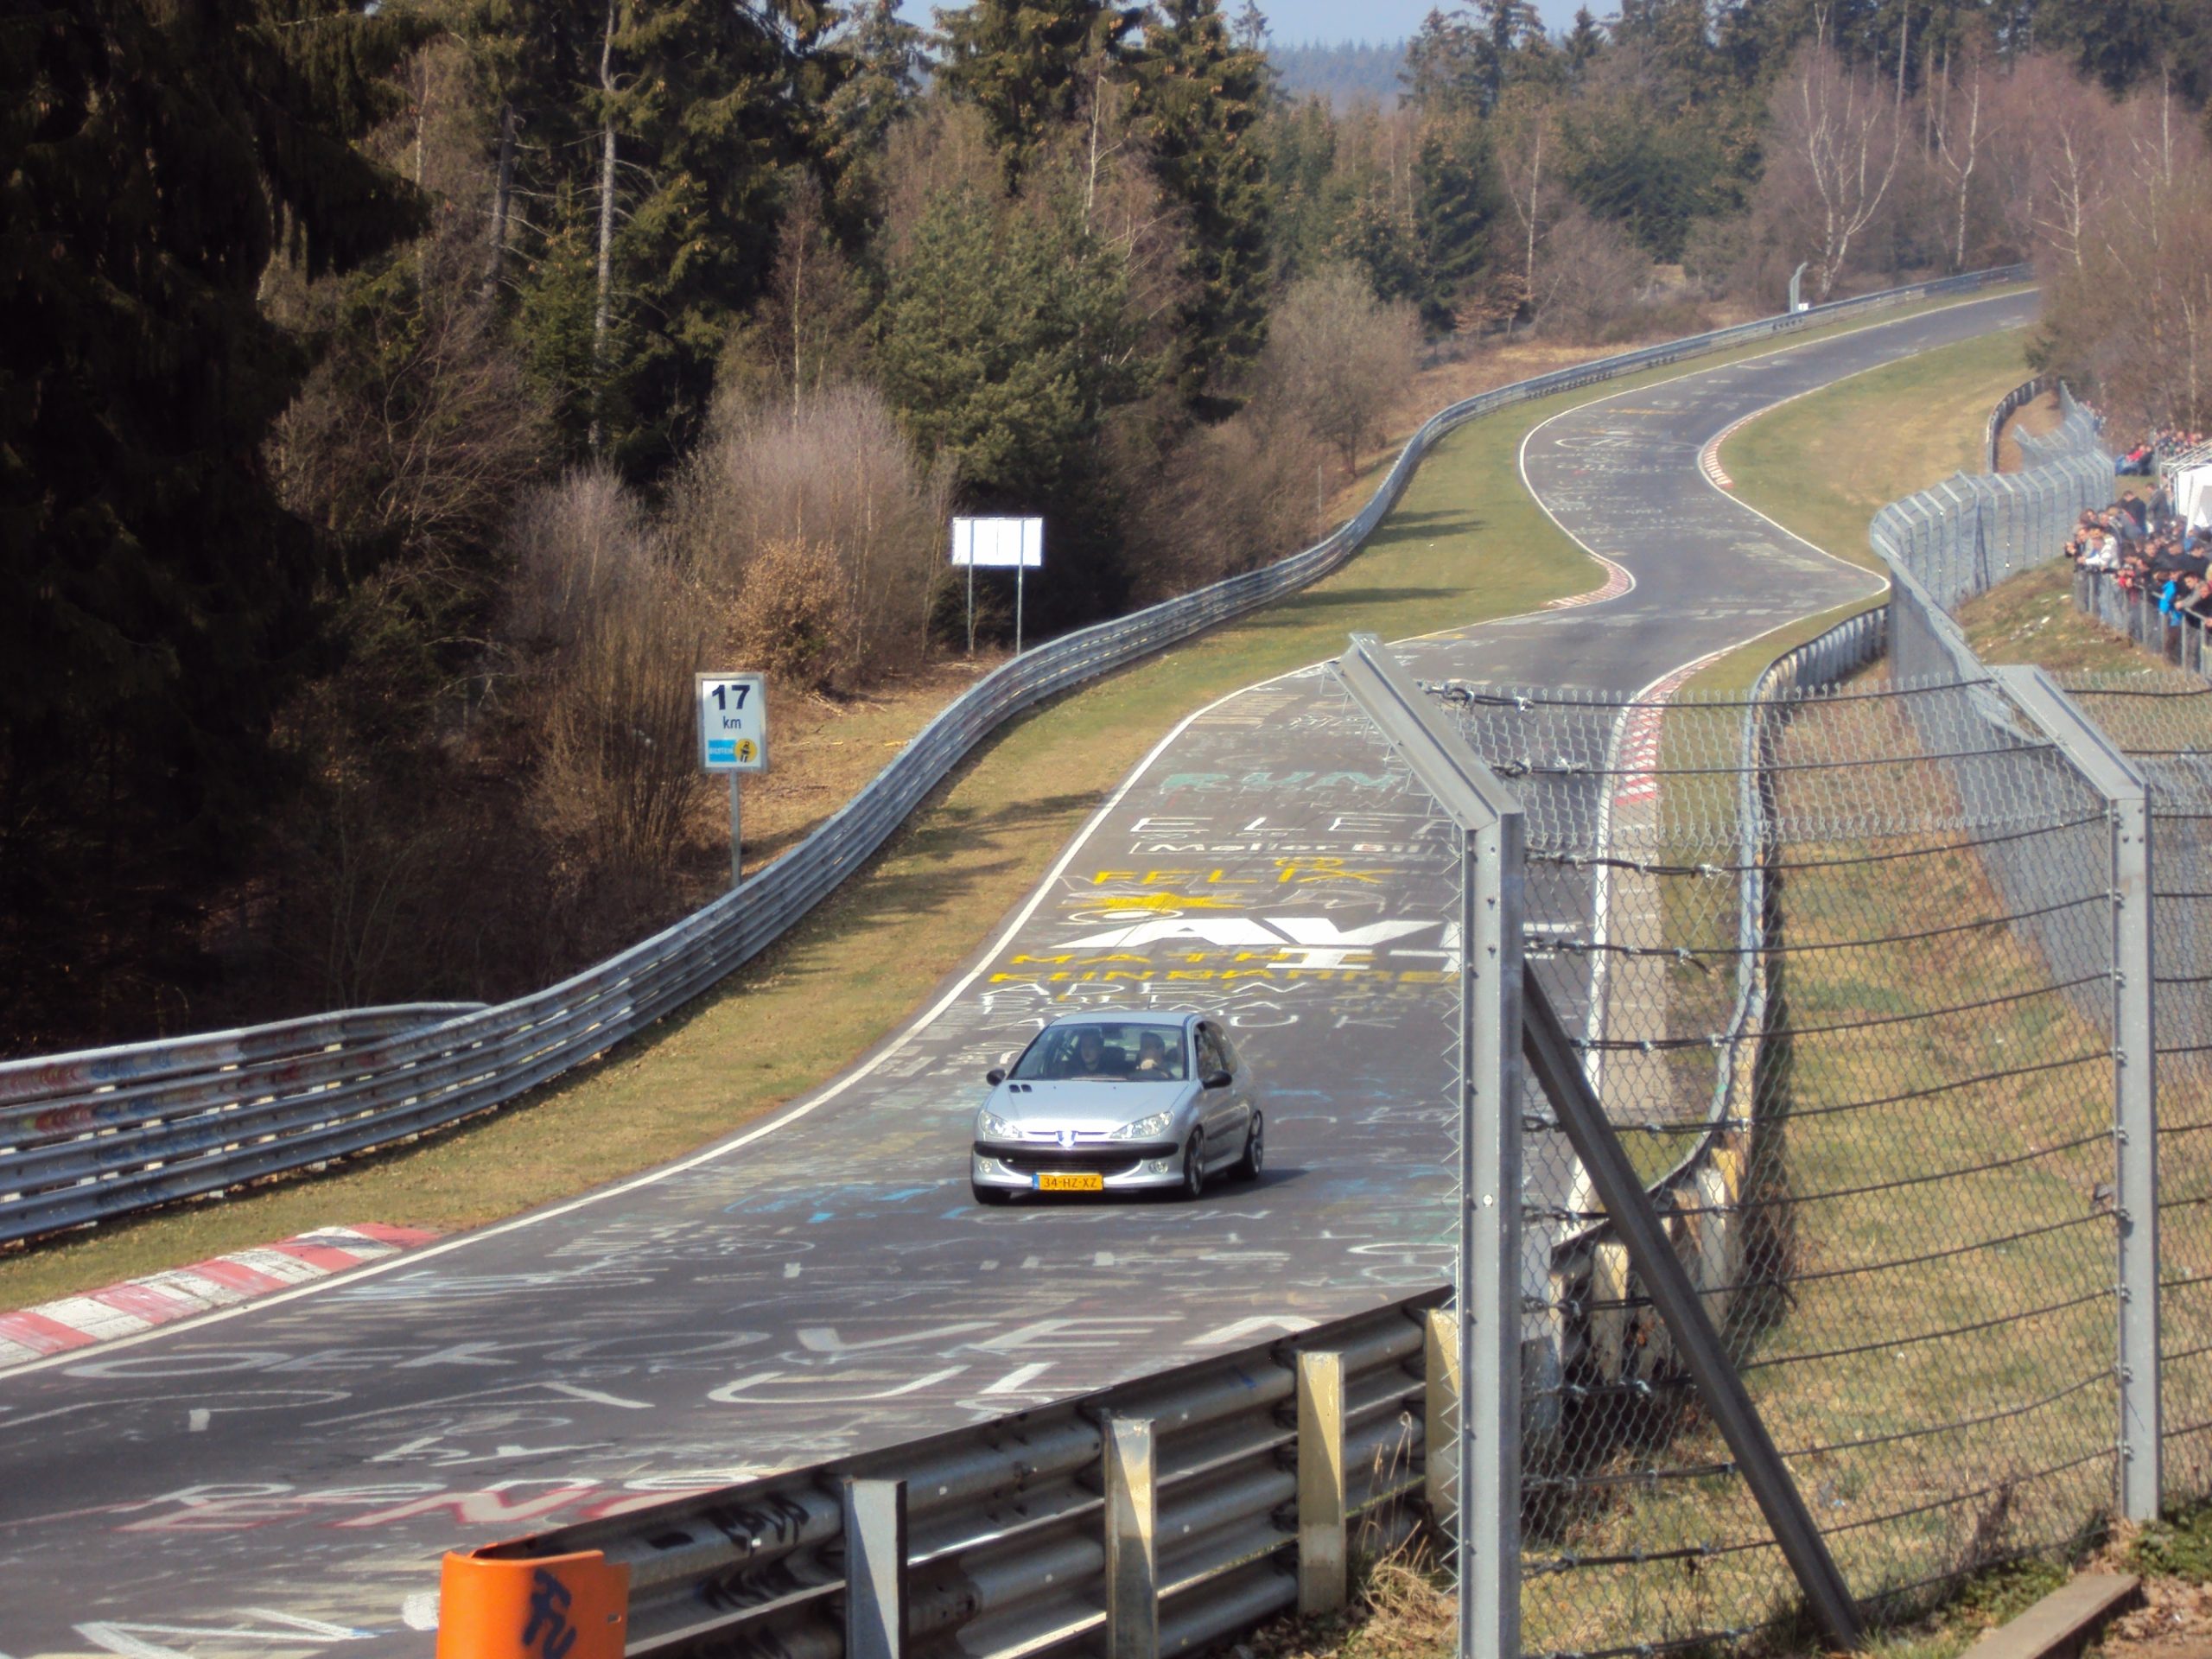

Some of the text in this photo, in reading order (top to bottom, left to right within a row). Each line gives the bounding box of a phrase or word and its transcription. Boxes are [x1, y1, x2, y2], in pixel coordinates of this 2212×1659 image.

[711, 684, 751, 710] 17
[722, 715, 742, 729] km
[1092, 867, 1394, 885] FELIX
[362, 1437, 616, 1467] by
